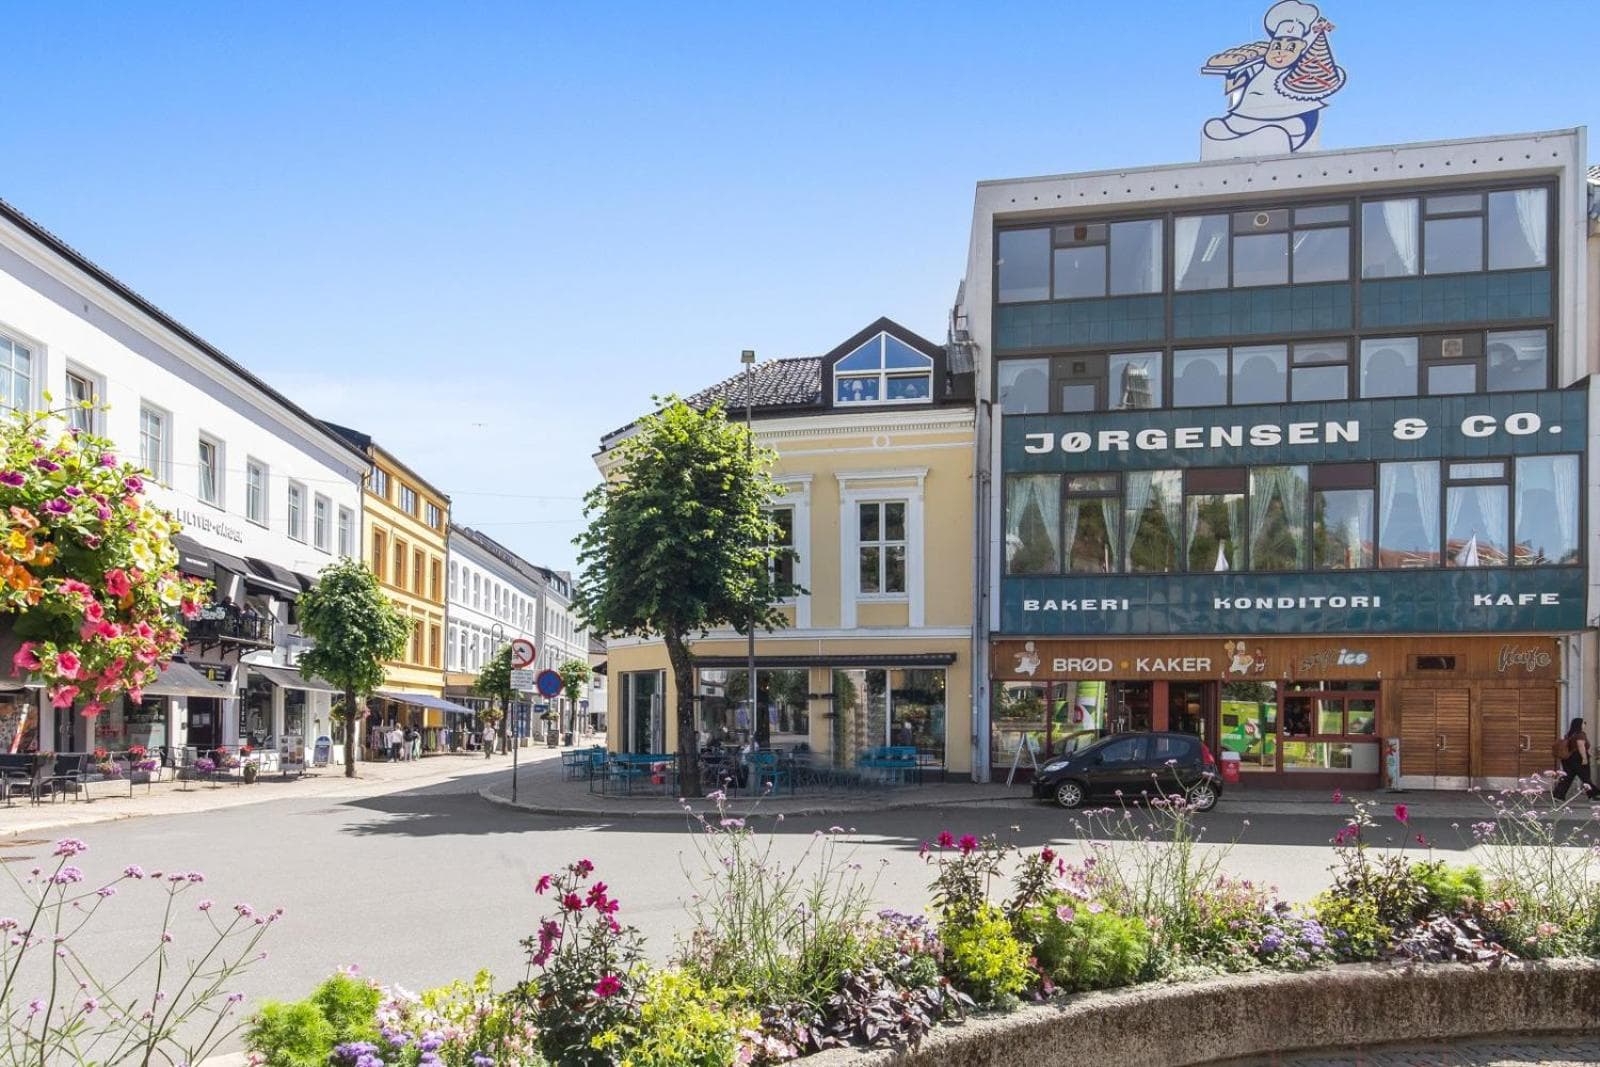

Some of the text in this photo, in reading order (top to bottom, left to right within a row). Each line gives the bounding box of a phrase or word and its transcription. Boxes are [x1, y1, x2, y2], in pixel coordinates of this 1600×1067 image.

[1024, 412, 1562, 454] JØRGENSEN & CO.
[1023, 598, 1129, 611] BAKERI
[1213, 596, 1381, 610] KONDITORI
[1473, 592, 1560, 606] KAFE
[1052, 657, 1211, 672] BRØD KAKER
